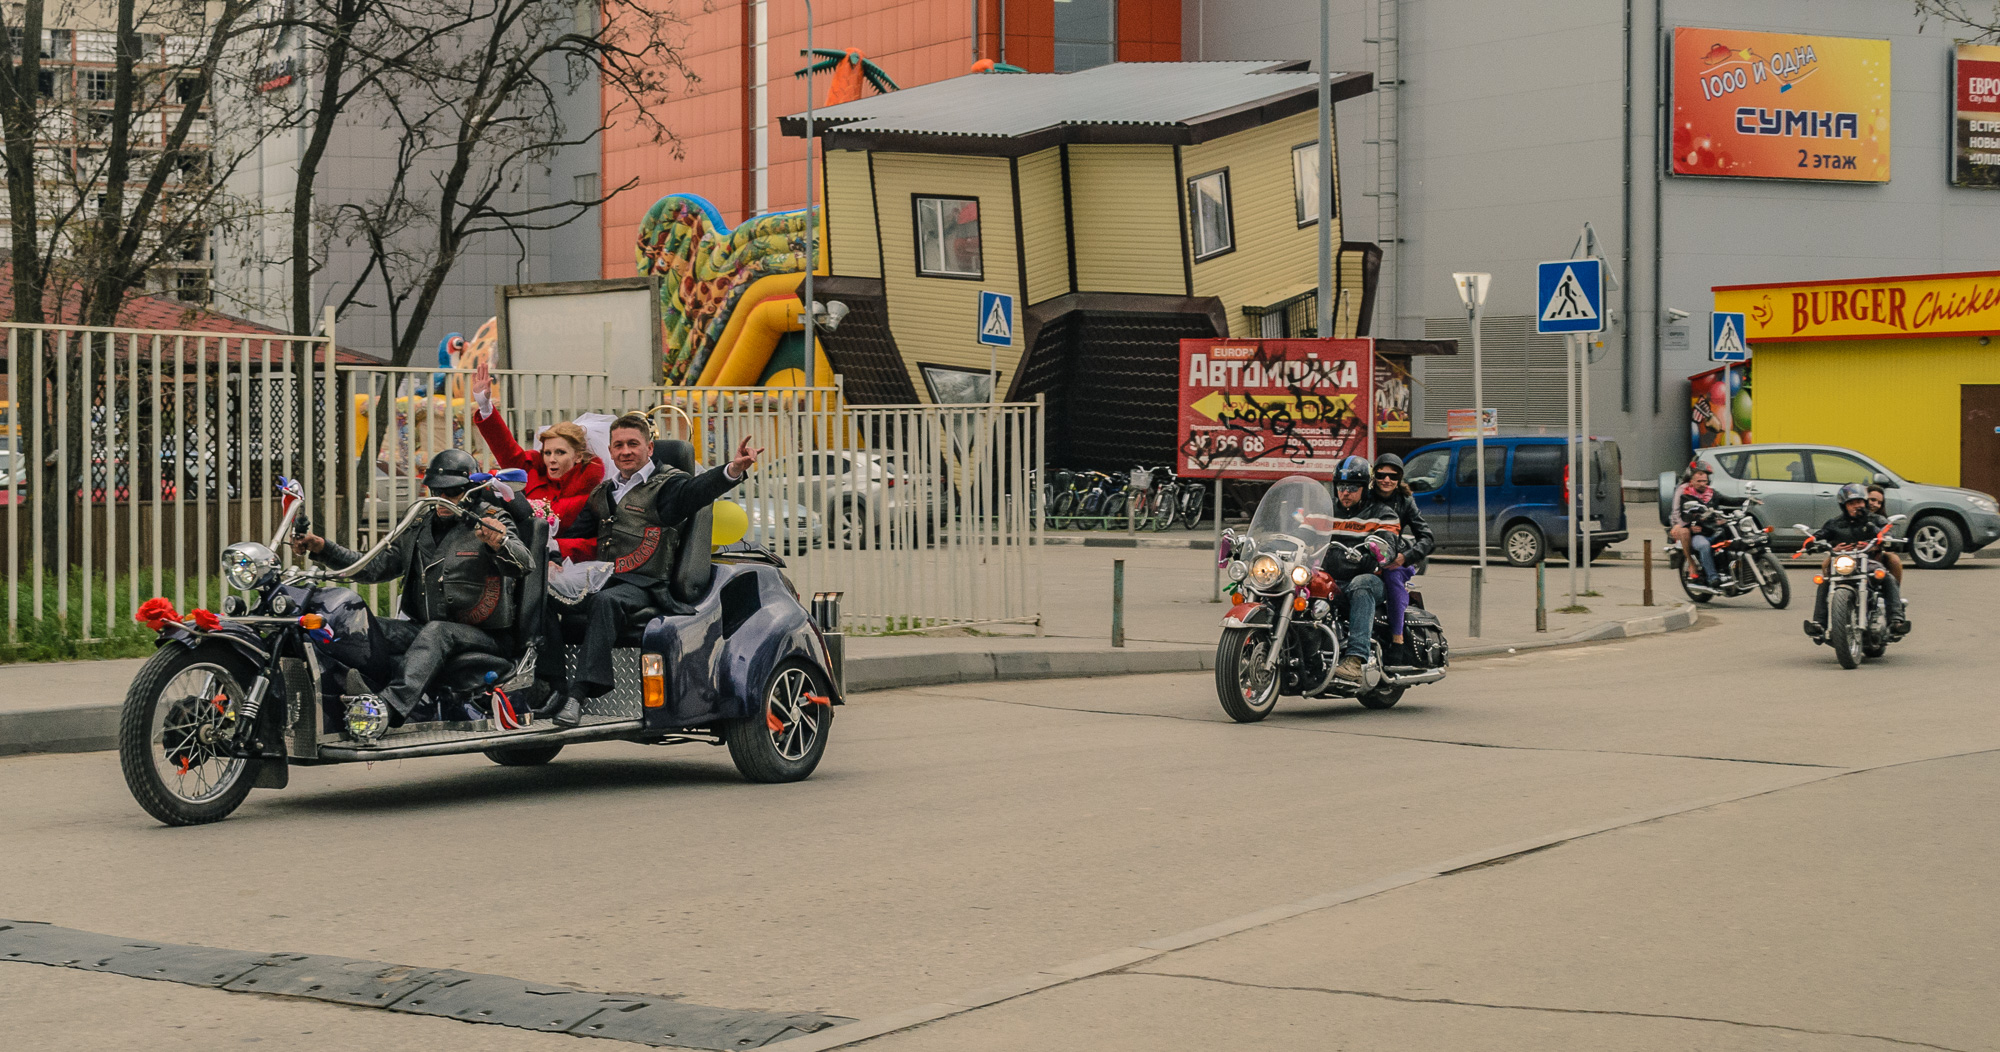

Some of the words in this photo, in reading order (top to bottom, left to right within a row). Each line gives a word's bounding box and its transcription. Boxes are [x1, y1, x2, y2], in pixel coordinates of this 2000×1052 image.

[1700, 67, 1747, 101] 1000
[1752, 60, 1767, 84] И
[1771, 44, 1818, 78] ОДНА
[1735, 106, 1858, 140] СУМКА
[1797, 149, 1808, 168] 2
[1813, 153, 1858, 170] этаж
[1791, 287, 1908, 335] BURGER
[1213, 347, 1255, 358] EUROPA
[1243, 436, 1264, 453] 68
[617, 529, 660, 572] РОССИЯ
